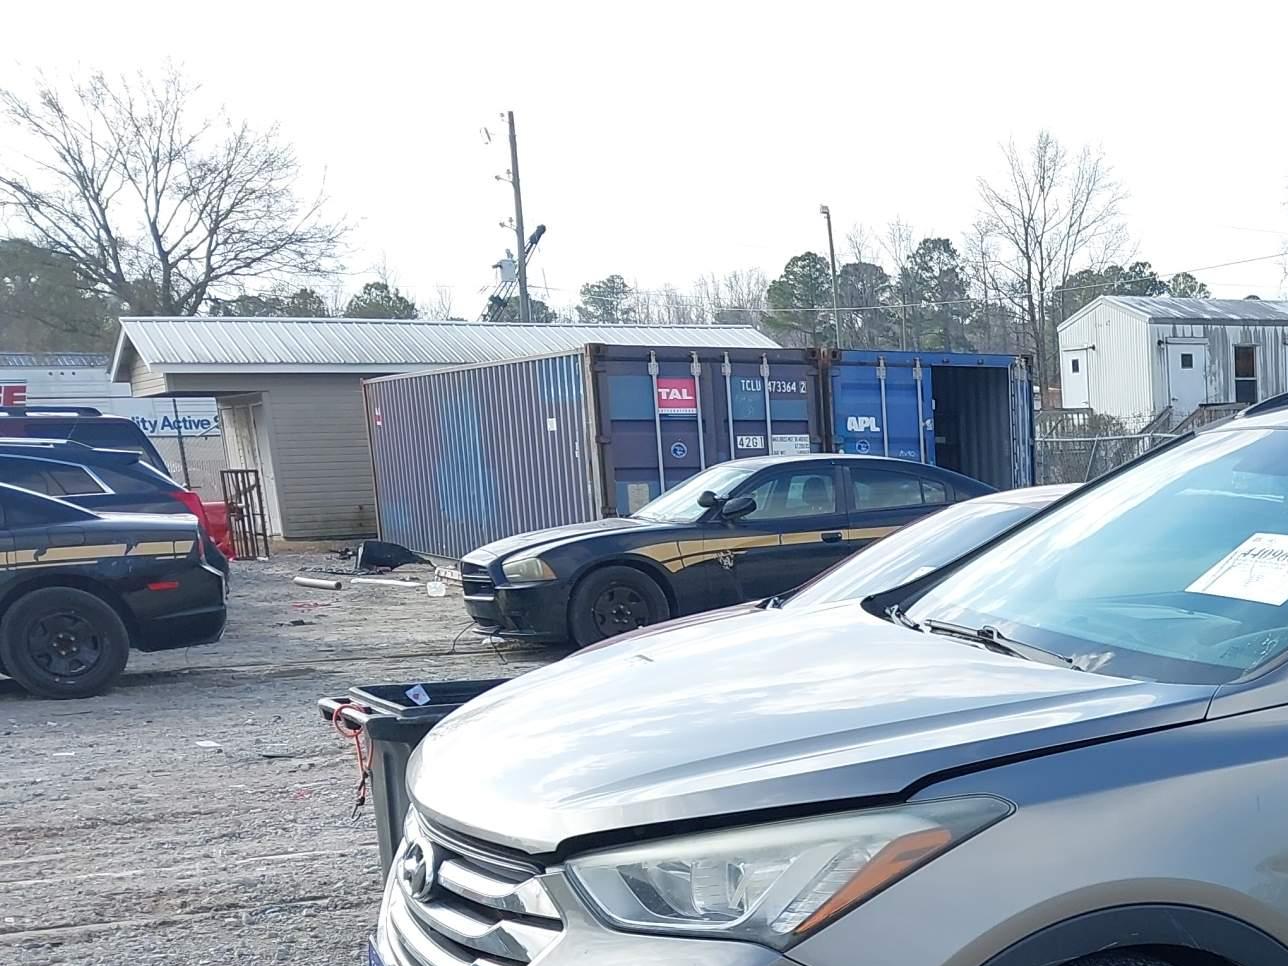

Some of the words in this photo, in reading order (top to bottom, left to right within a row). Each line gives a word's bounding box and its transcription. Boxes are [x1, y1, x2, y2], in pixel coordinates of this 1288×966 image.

[740, 380, 762, 392] TCLU
[658, 389, 695, 400] TAL
[160, 415, 211, 432] Active
[846, 416, 881, 432] APL
